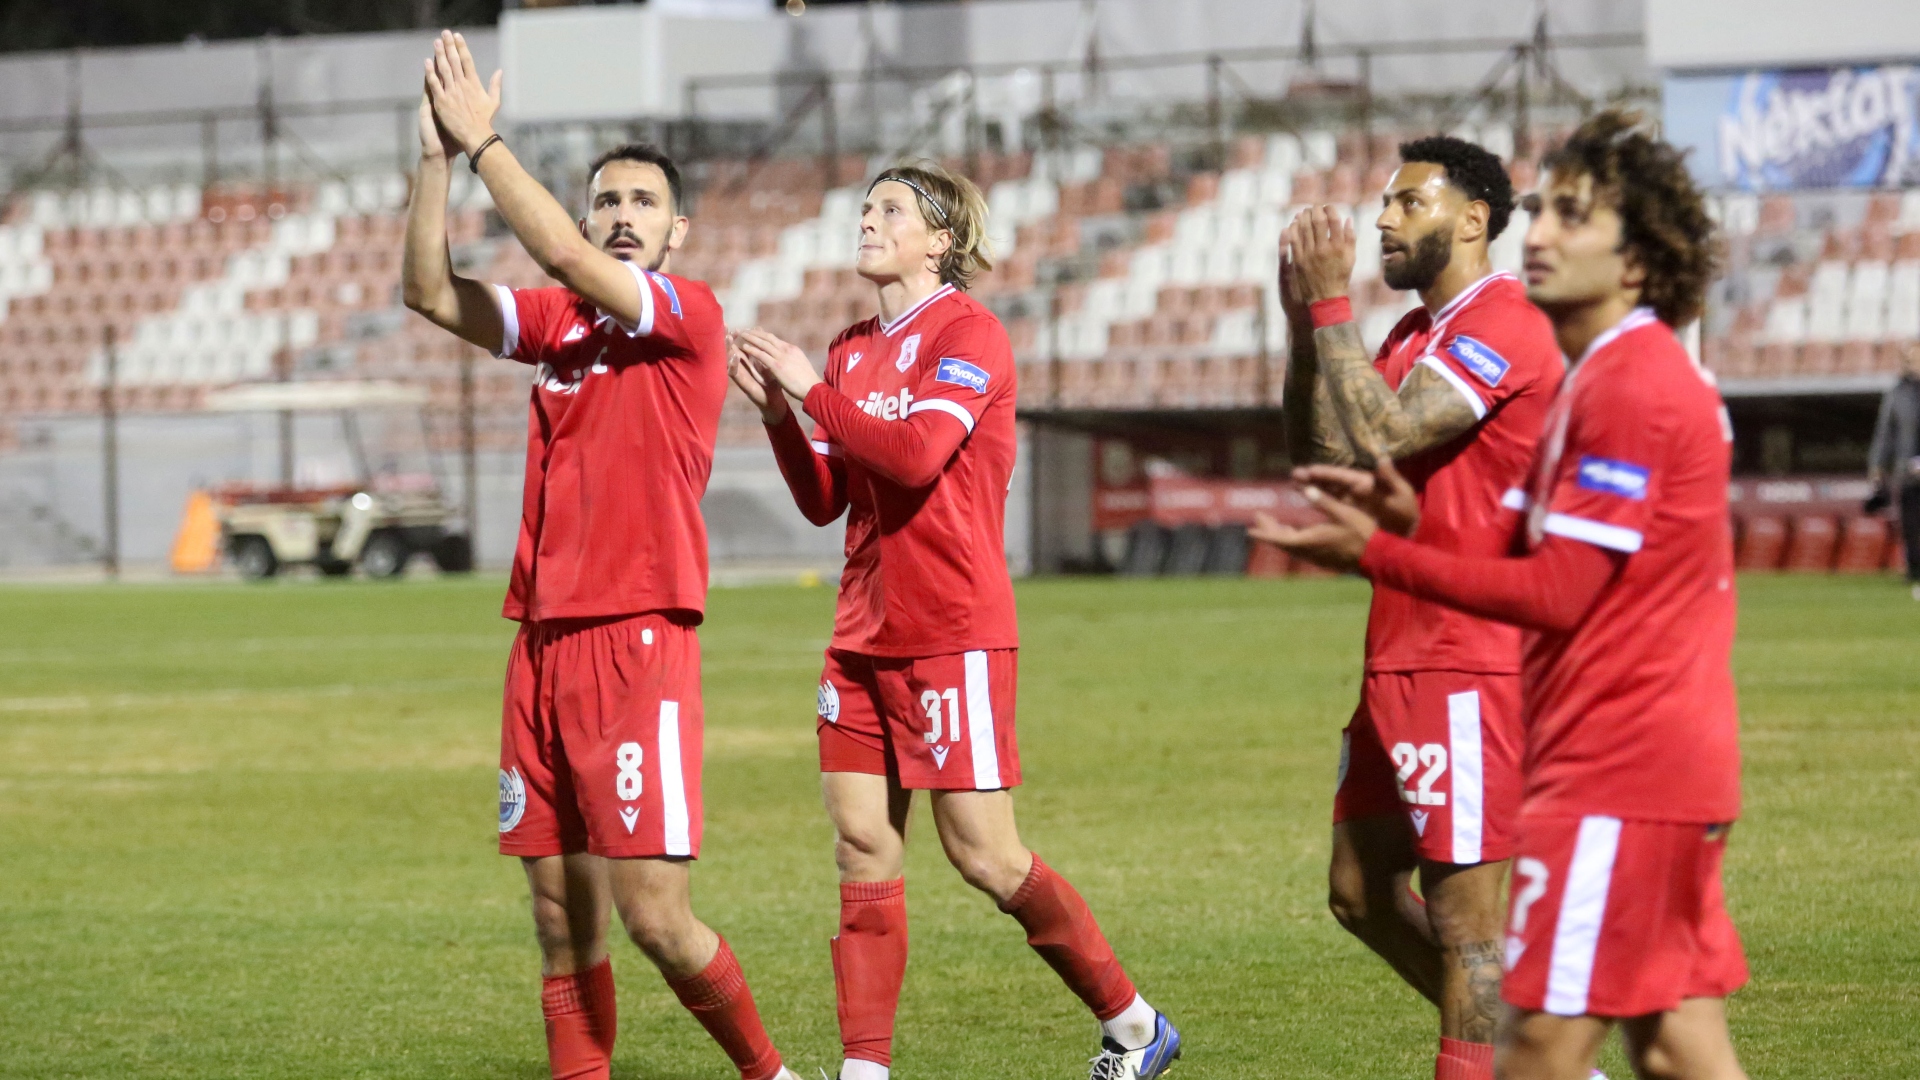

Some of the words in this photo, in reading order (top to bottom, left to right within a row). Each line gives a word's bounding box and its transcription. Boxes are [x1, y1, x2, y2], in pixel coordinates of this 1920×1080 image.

[920, 687, 961, 744] 31
[616, 741, 643, 801] 8
[1391, 742, 1447, 805] 22
